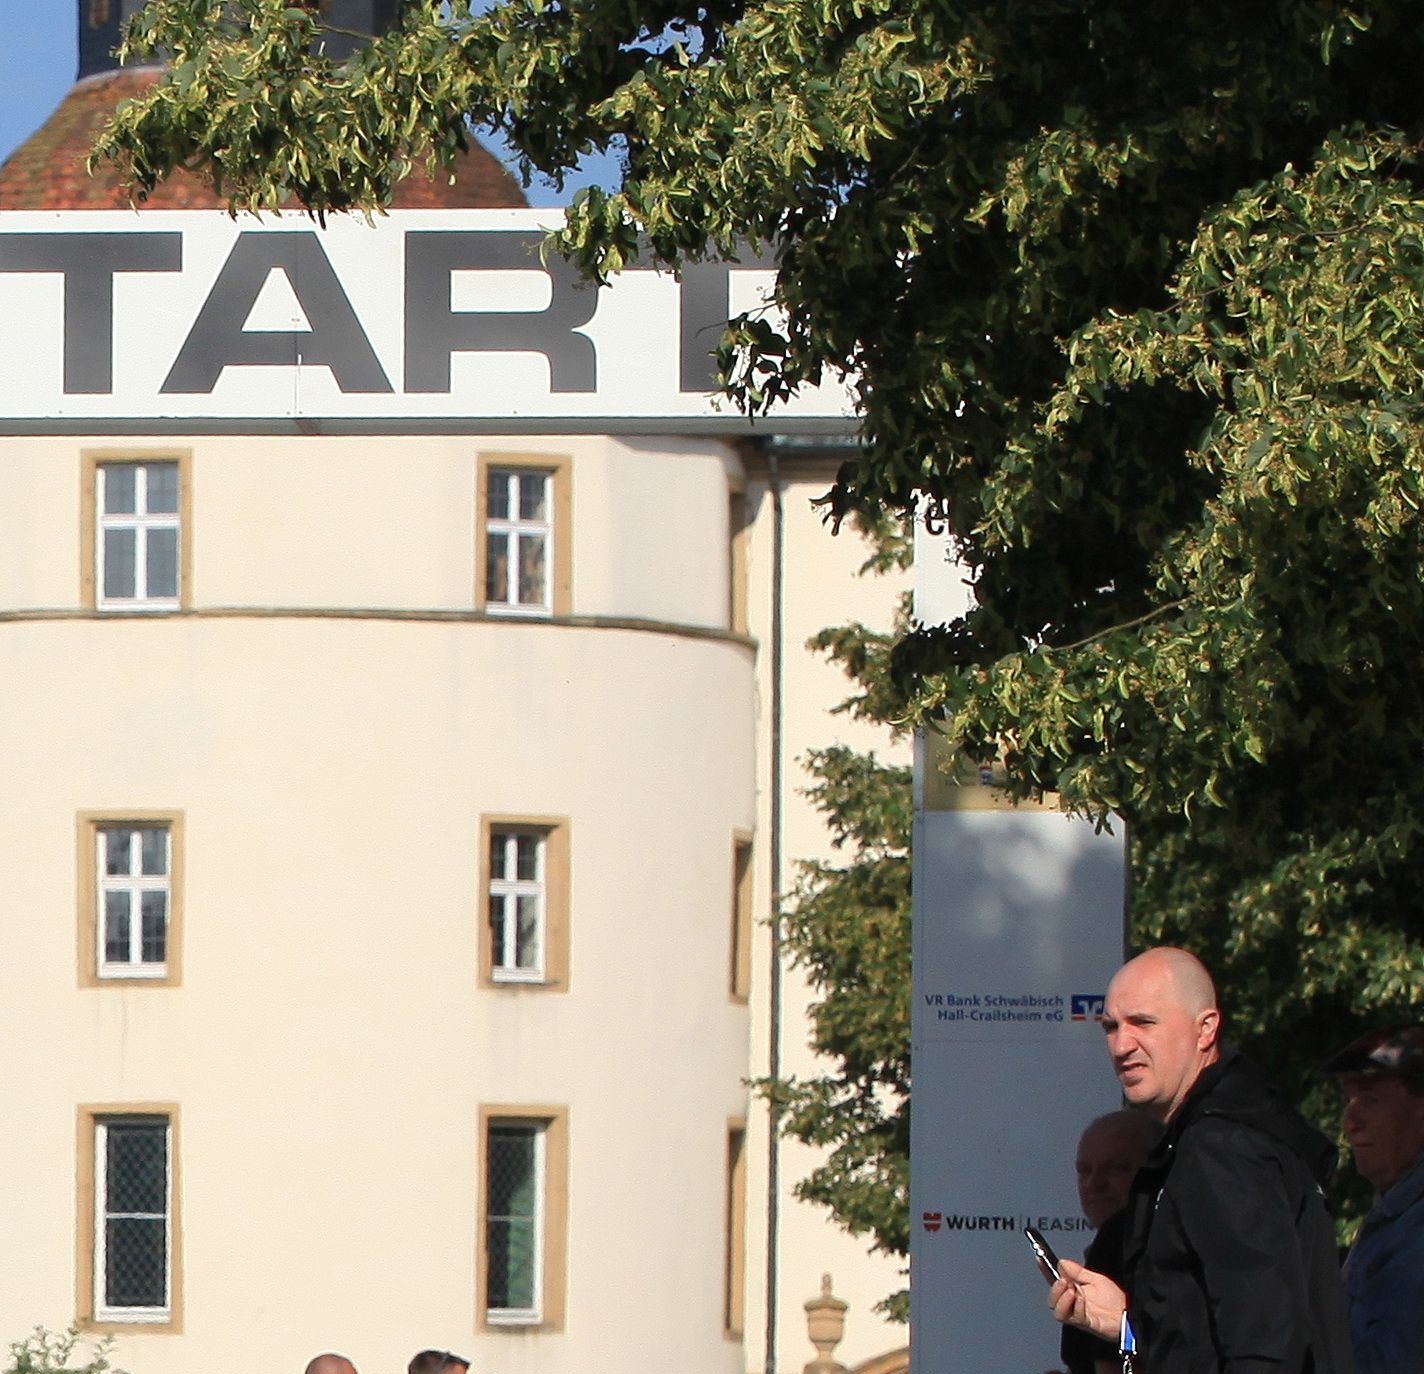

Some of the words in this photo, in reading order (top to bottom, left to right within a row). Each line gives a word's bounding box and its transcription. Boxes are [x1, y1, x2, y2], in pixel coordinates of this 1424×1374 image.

[924, 994, 943, 1006] VR
[947, 994, 980, 1007] Bank
[984, 994, 1065, 1007] Schwäbisch
[937, 1009, 1042, 1022] Hall-Crailsheim
[1045, 1010, 1064, 1022] eG
